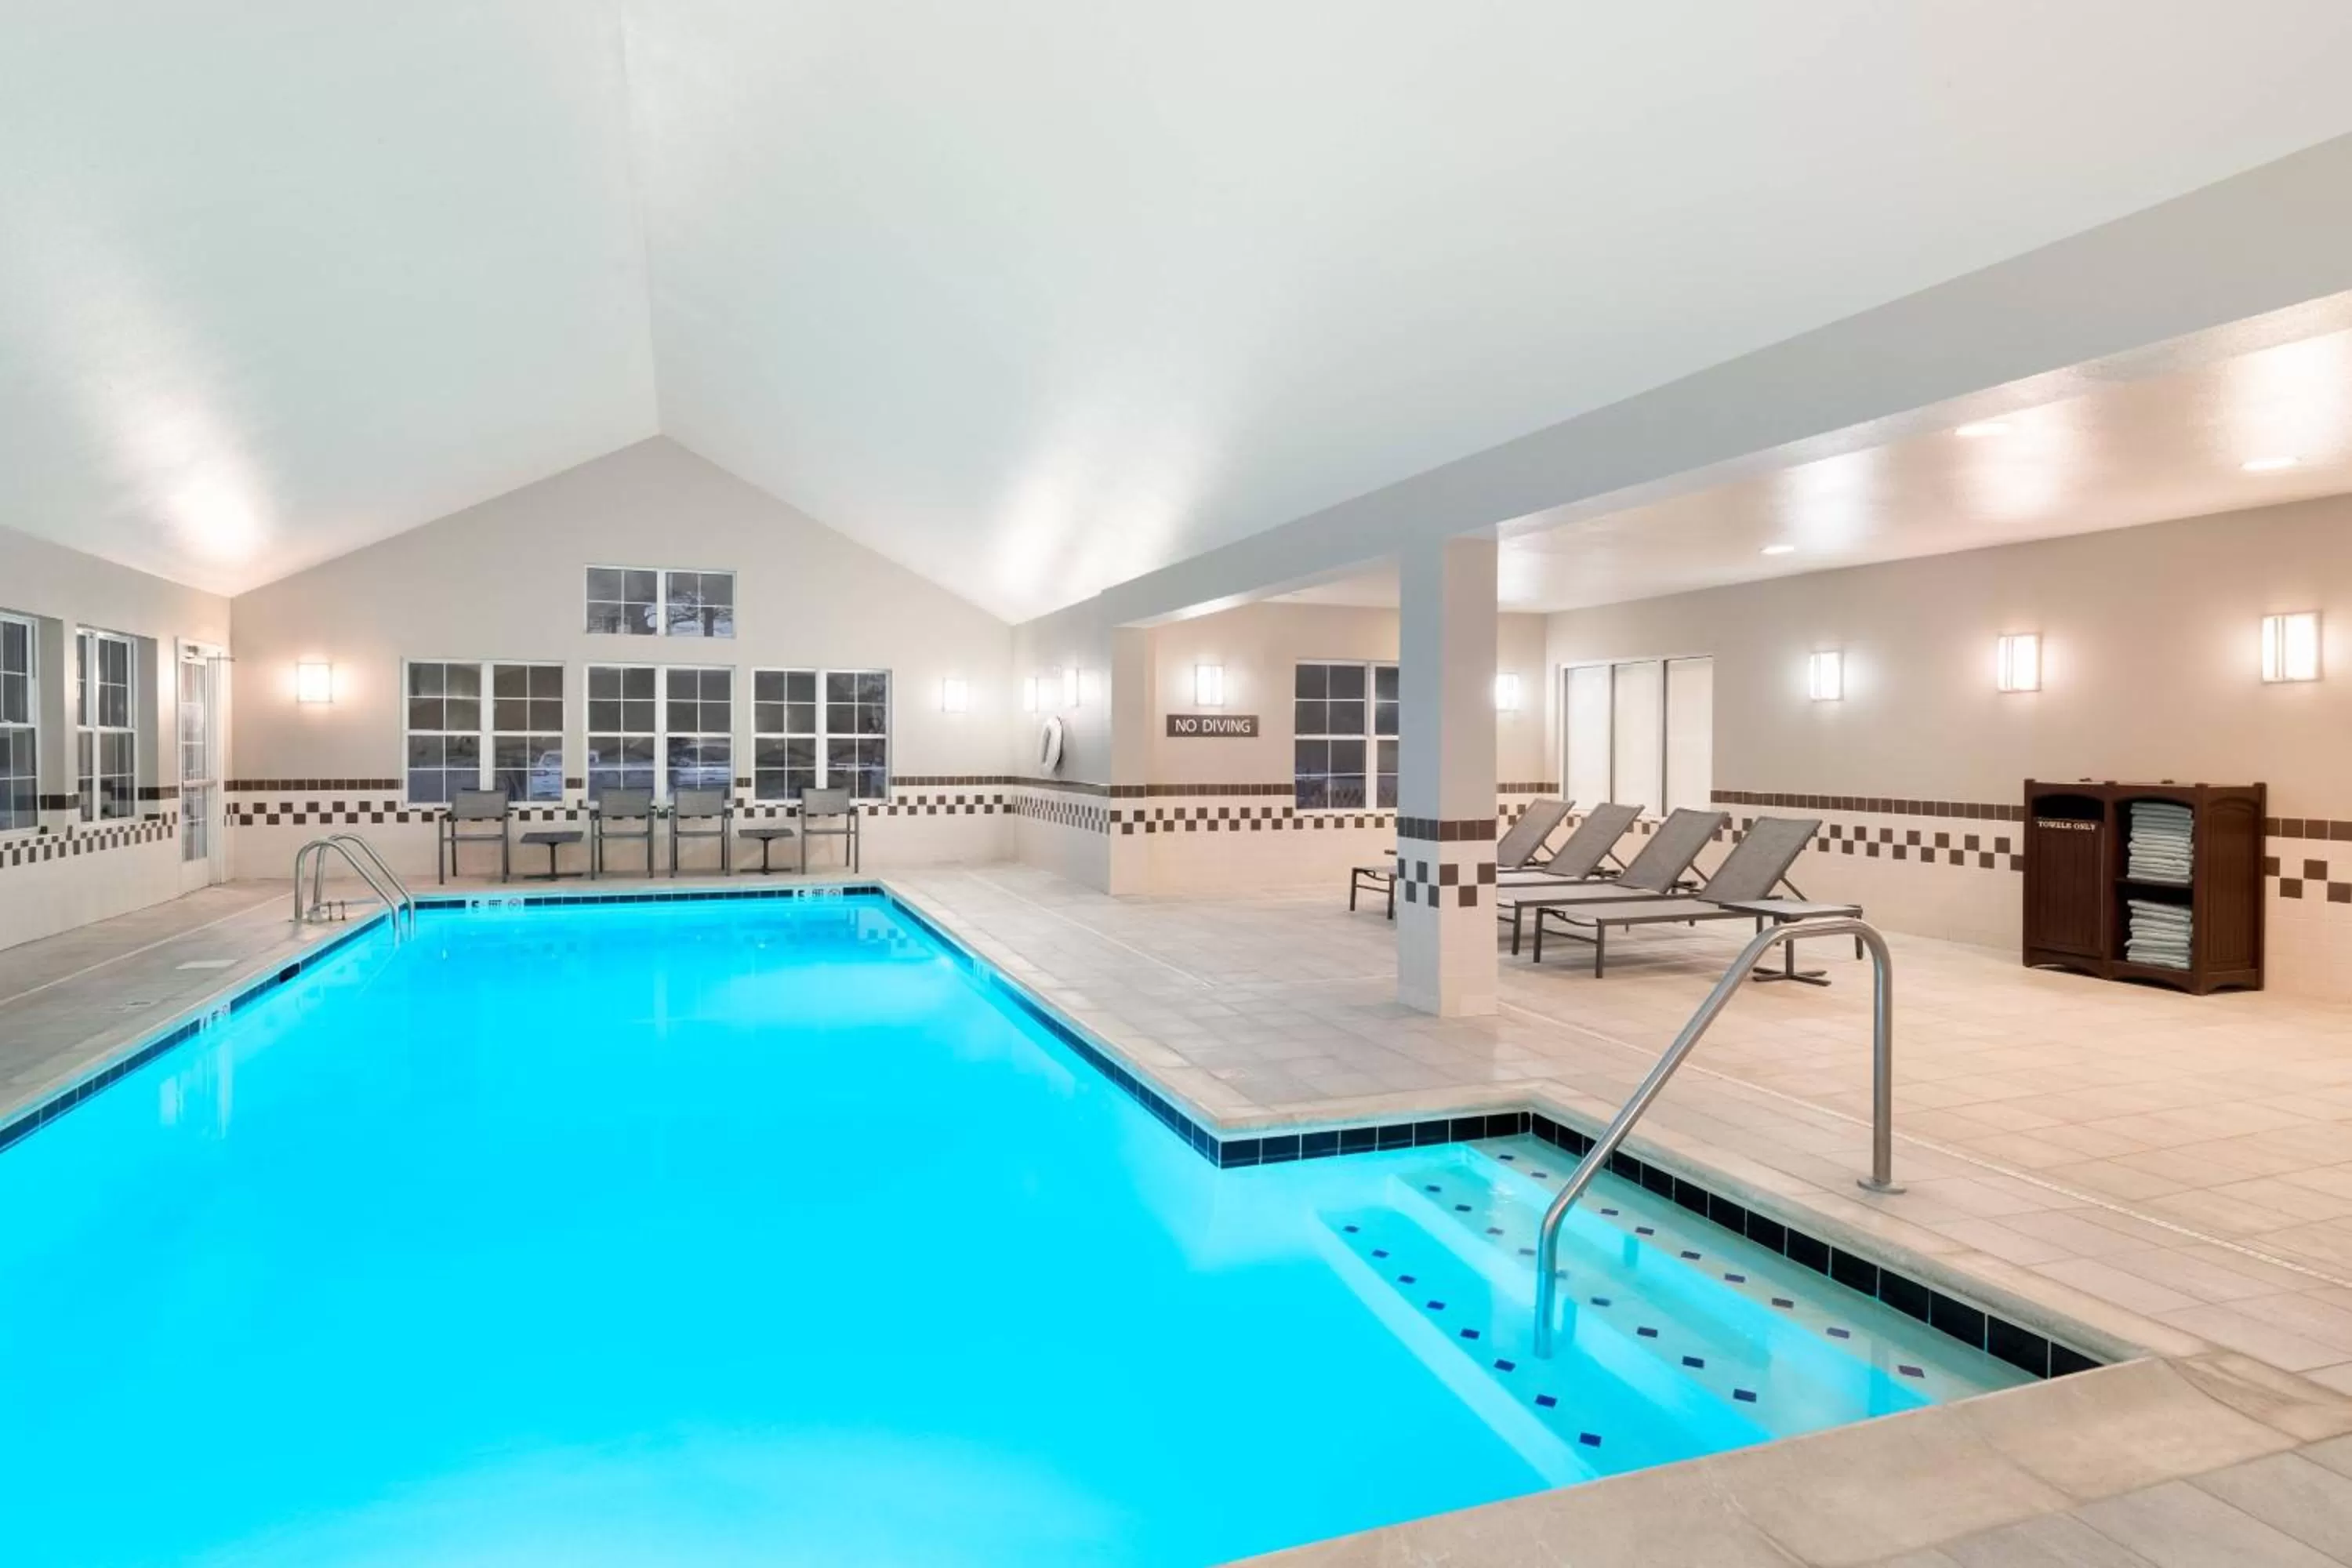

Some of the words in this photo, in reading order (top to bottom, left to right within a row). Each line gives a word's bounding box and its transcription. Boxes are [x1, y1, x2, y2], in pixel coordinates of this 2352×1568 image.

[1175, 719, 1197, 733] NO
[1202, 719, 1250, 733] DIVING
[2073, 822, 2096, 832] ONLY
